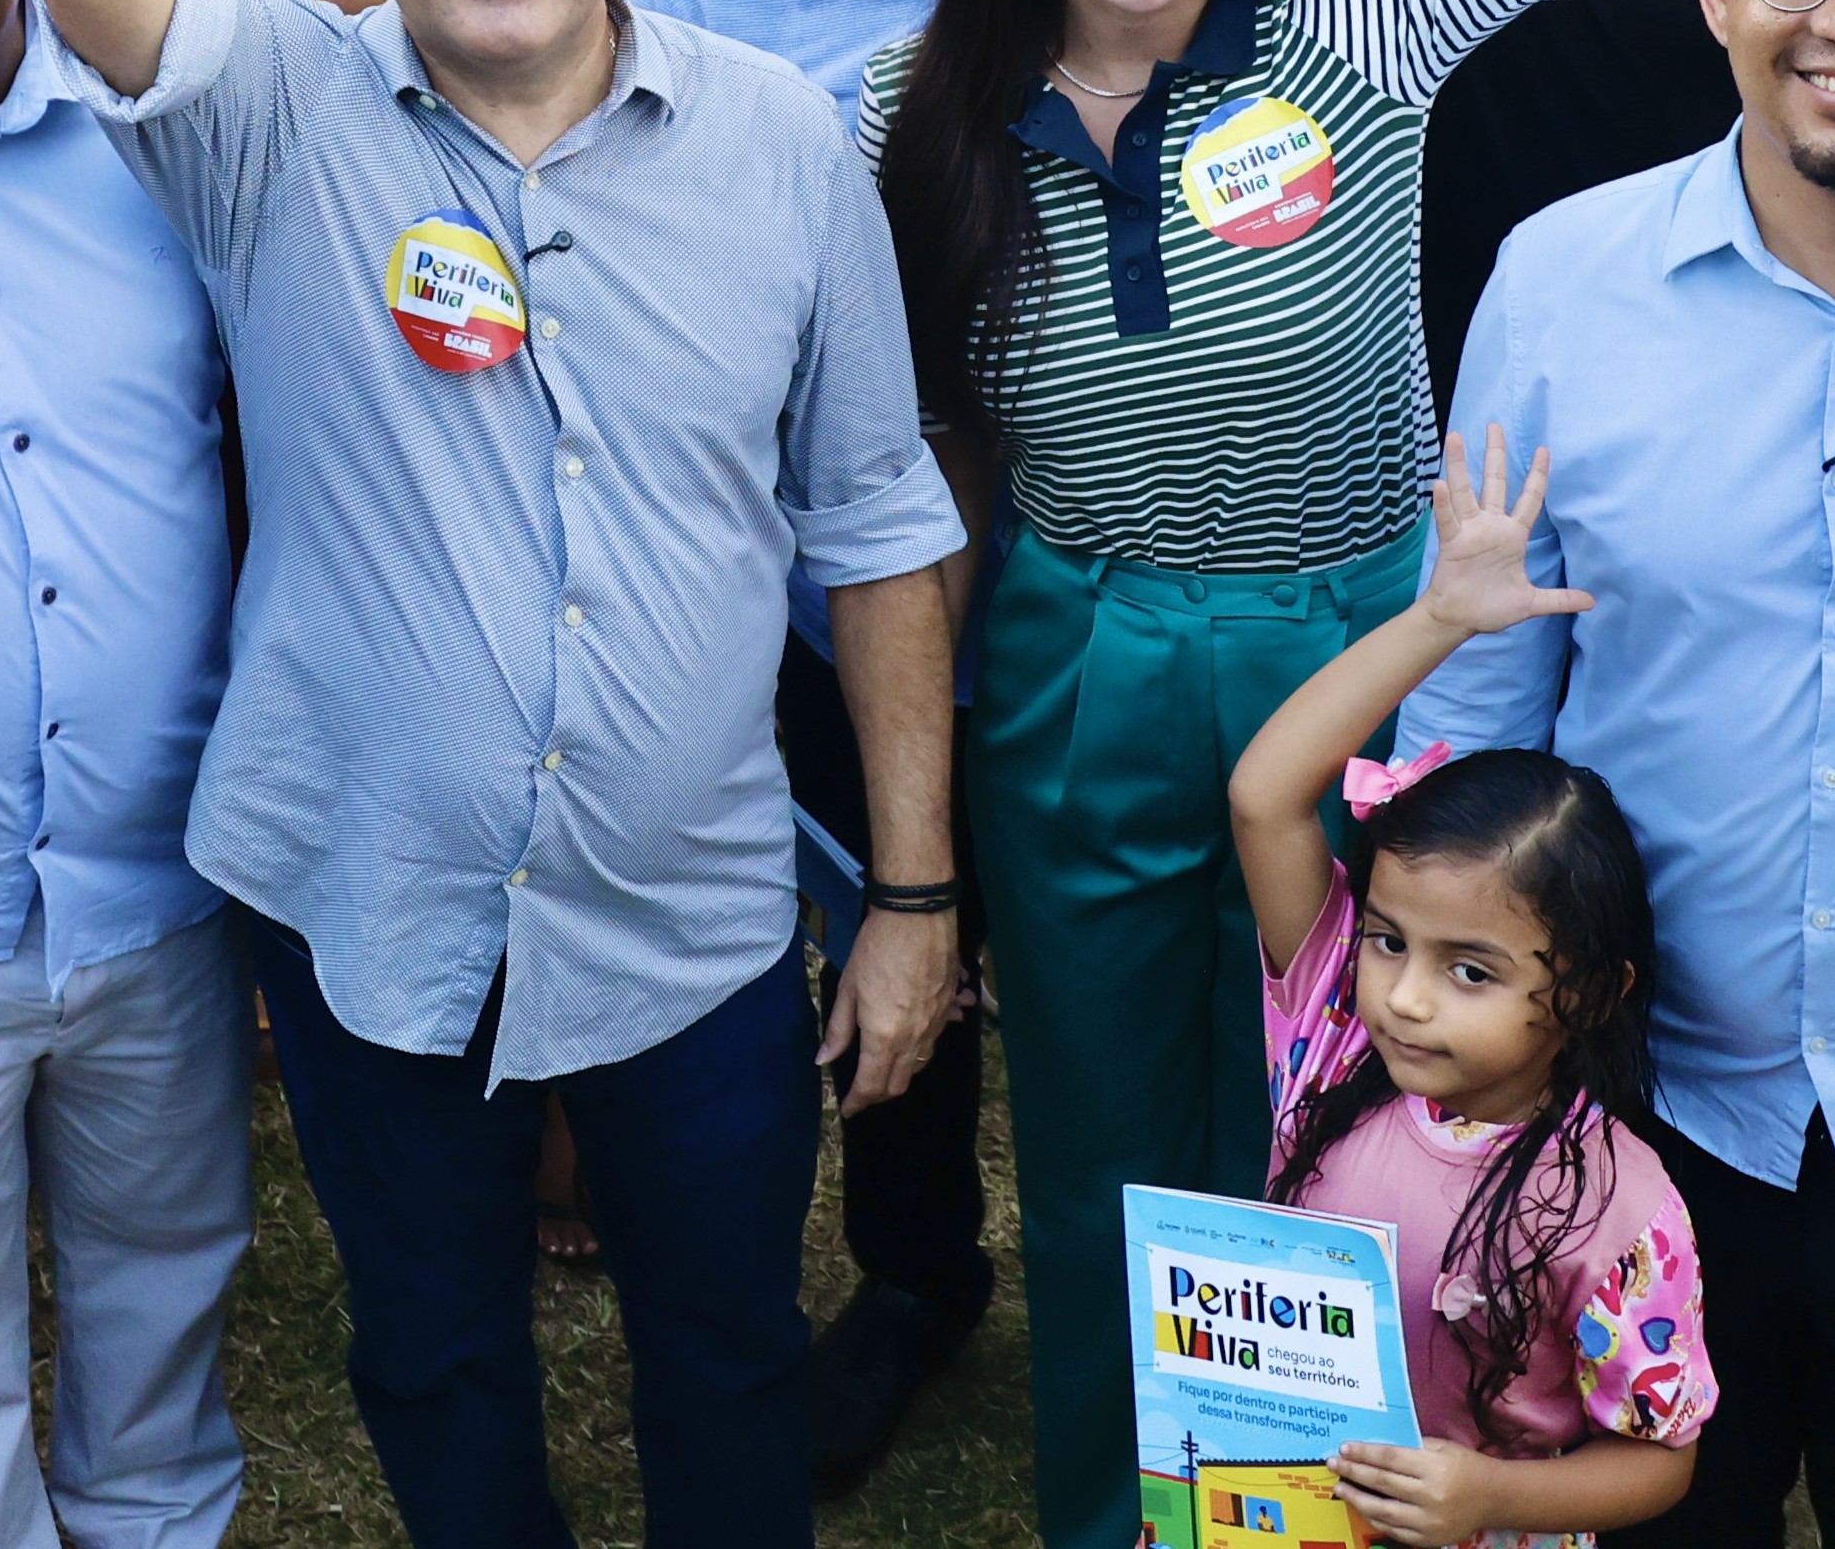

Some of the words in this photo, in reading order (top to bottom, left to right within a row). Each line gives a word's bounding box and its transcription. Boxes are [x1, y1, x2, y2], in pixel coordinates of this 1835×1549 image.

[1207, 132, 1312, 185] Periferia
[1215, 173, 1270, 205] Viva
[413, 275, 464, 309] Viva
[415, 250, 514, 308] Periferia
[1169, 1265, 1355, 1339] Periferia
[1172, 1313, 1260, 1371] Viva
[1266, 1346, 1316, 1366] chegou
[1318, 1356, 1335, 1368] ao
[1267, 1362, 1292, 1379] seu
[1293, 1365, 1361, 1389] território:
[1177, 1380, 1211, 1403] Fique
[1213, 1388, 1233, 1406] por
[1234, 1392, 1277, 1413] dentro
[1278, 1402, 1287, 1413] e
[1288, 1400, 1349, 1425] participe
[1197, 1402, 1233, 1422] dessa
[1233, 1407, 1331, 1439] transformação!
